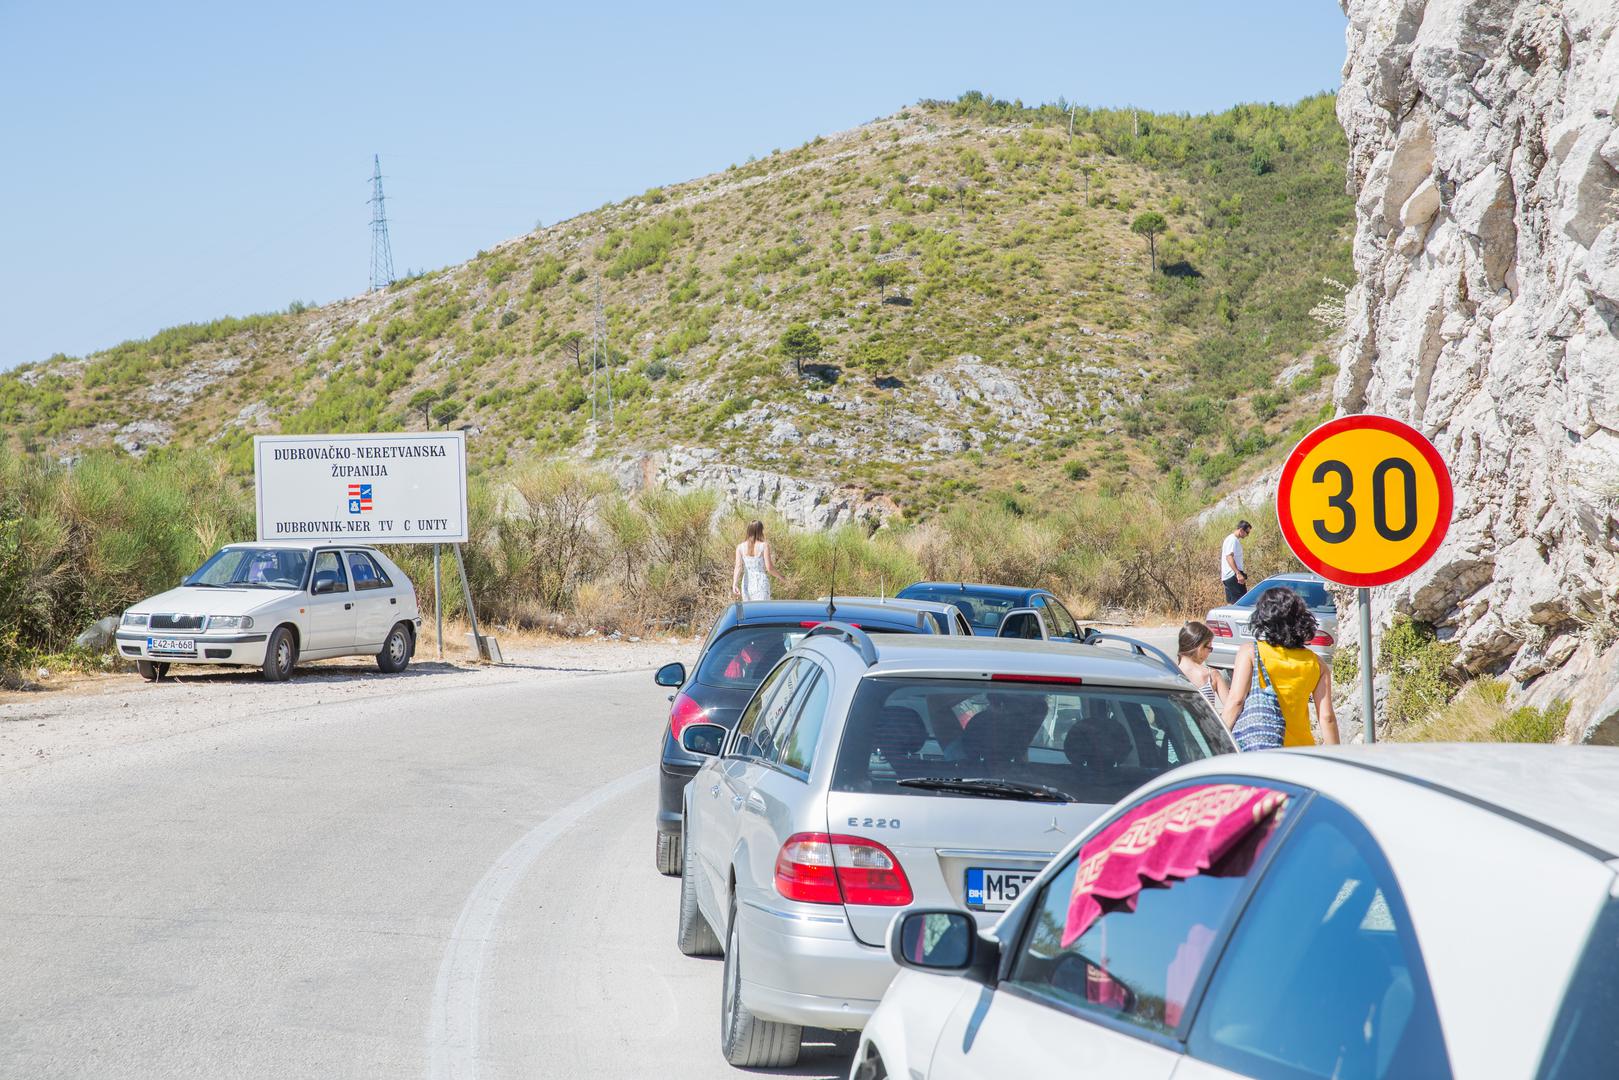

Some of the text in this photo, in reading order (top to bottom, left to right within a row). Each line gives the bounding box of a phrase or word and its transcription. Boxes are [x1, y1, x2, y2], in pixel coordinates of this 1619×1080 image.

[331, 464, 388, 477] ŽUPANIJA
[1312, 457, 1418, 544] 30
[152, 639, 193, 649] E42-A-668
